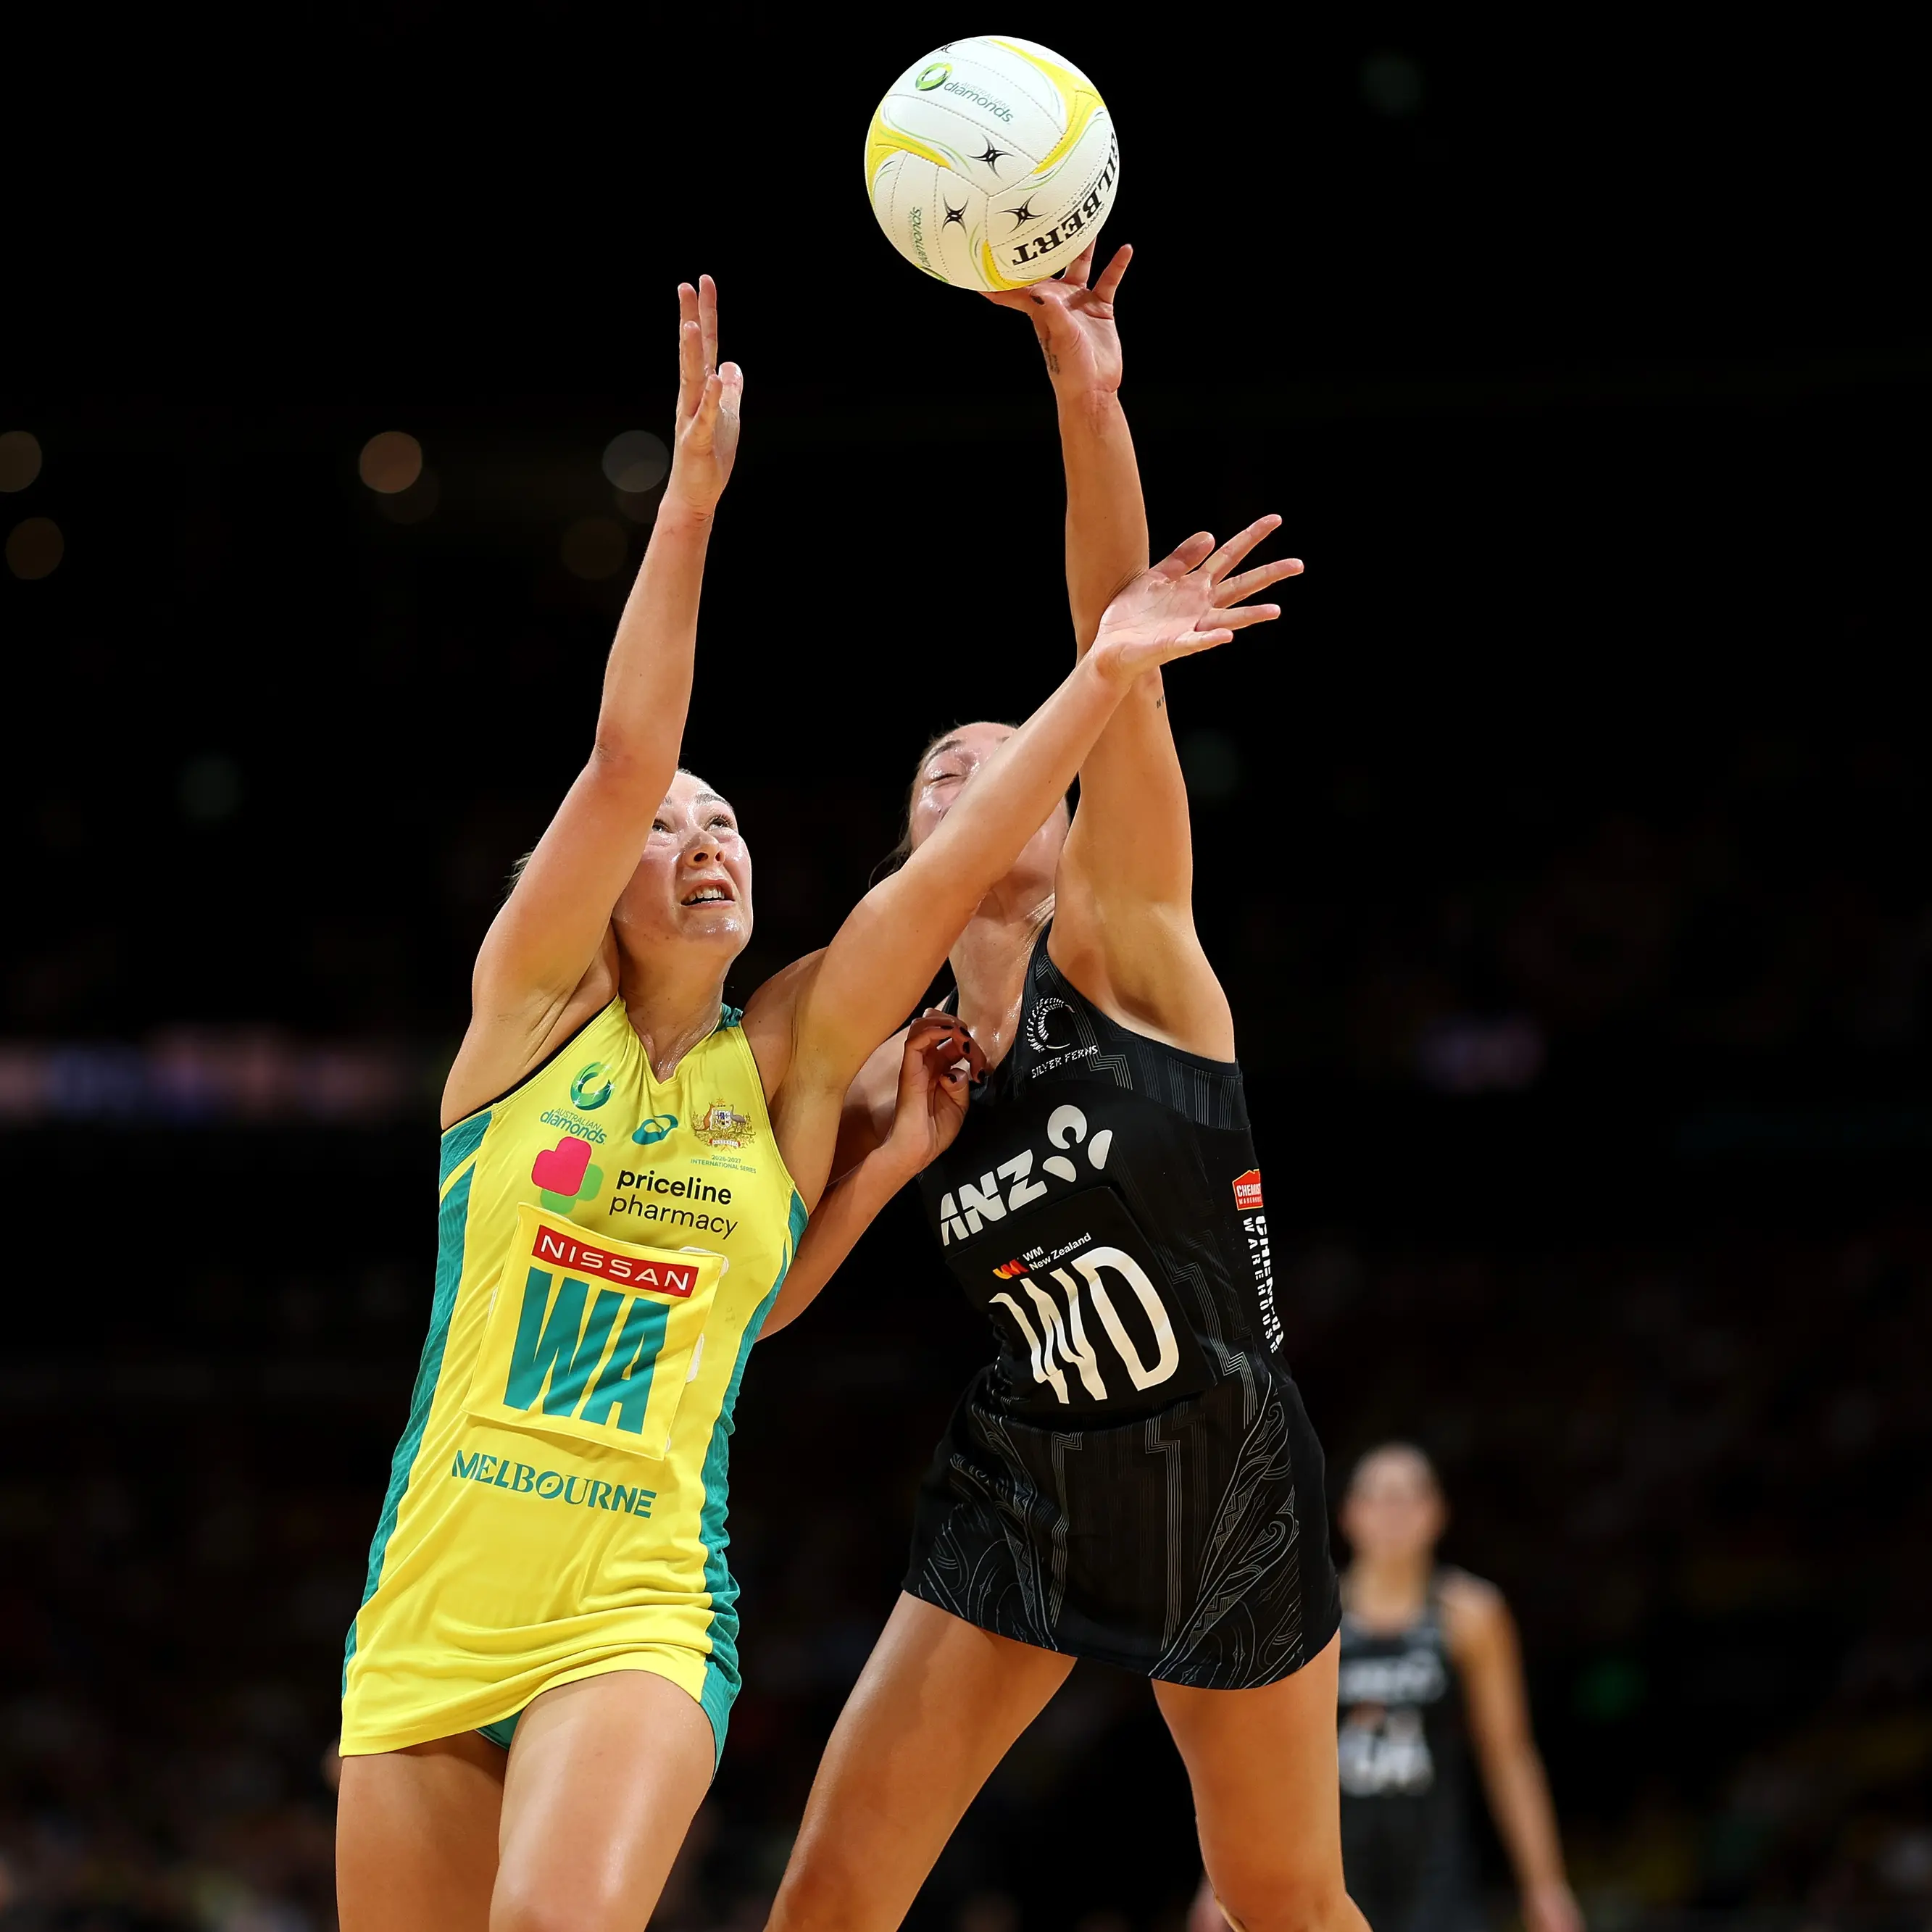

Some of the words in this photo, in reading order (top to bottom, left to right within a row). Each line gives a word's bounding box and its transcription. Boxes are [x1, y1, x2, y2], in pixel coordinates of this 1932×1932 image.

[944, 82, 1014, 123] diamonds
[1012, 132, 1118, 265] GILBERT
[1031, 1057, 1062, 1078] SILVER
[1065, 1045, 1099, 1063] FERNS
[540, 1110, 607, 1144] diamonds
[555, 1107, 601, 1130] AUSTRALIAN
[617, 1169, 732, 1205] priceline
[691, 1159, 738, 1170] INTERNATIONAL
[740, 1165, 757, 1174] SERIES
[609, 1194, 738, 1240] pharmacy
[941, 1149, 1049, 1246] ANZ
[541, 1234, 691, 1291] NISSAN
[1023, 1246, 1044, 1262] WM
[1029, 1256, 1052, 1270] New
[1050, 1232, 1091, 1260] Zealand
[1243, 1217, 1278, 1354] WAREHOUSE
[988, 1246, 1179, 1404] WD
[503, 1266, 670, 1435] WA
[451, 1450, 657, 1519] MELBOURNE
